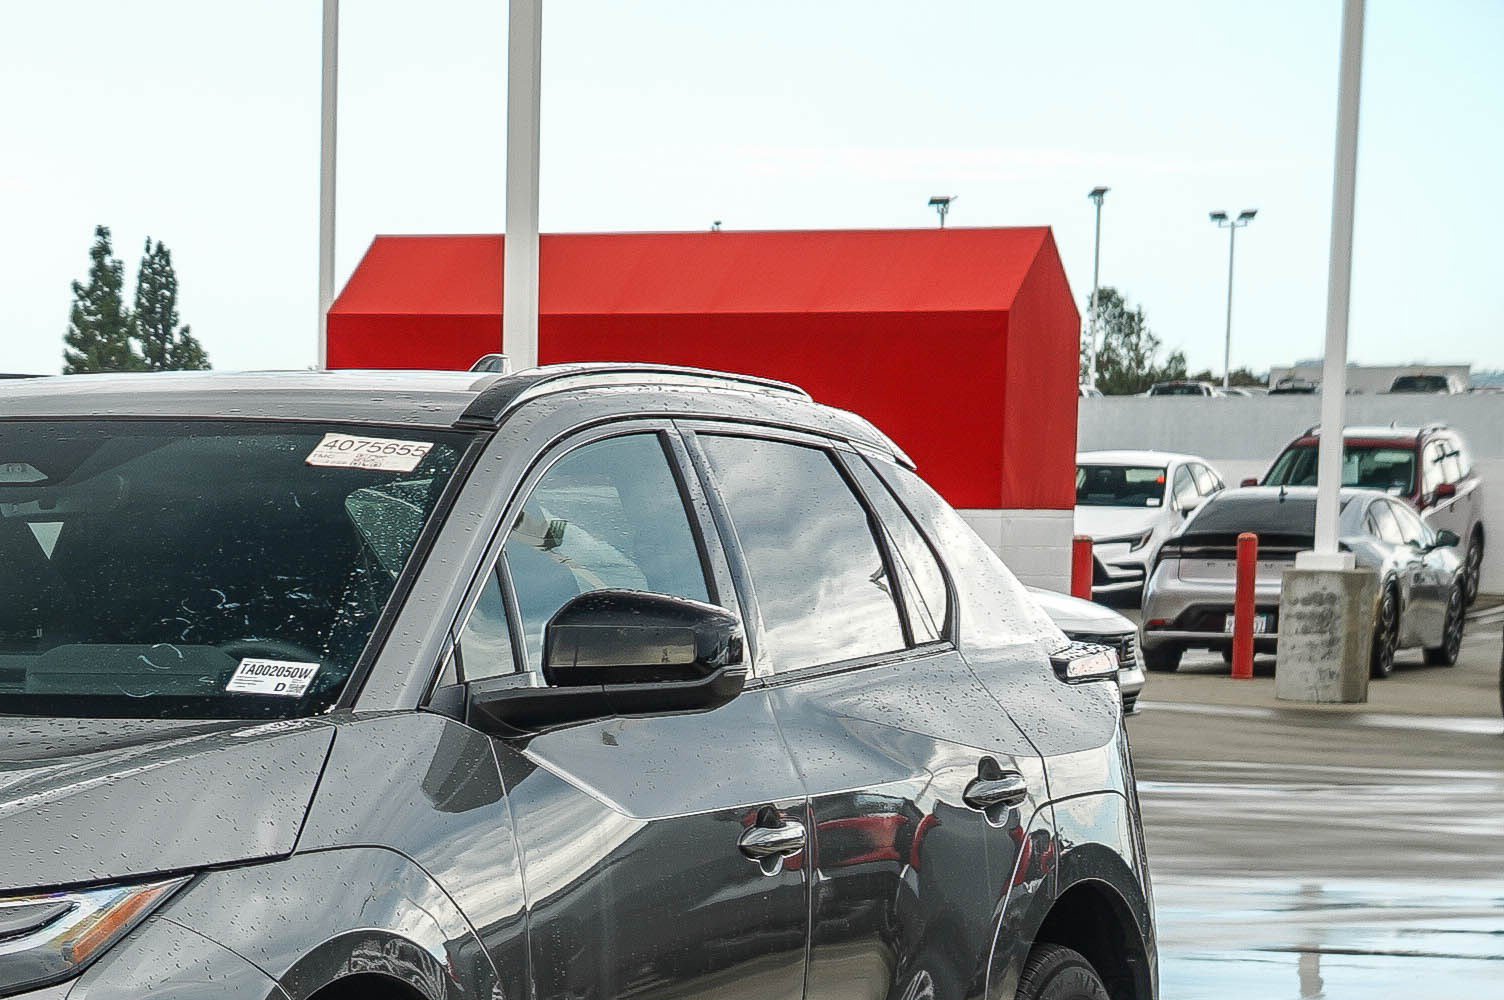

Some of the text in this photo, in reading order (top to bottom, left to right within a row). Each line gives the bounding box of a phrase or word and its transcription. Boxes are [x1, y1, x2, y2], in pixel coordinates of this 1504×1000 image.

[323, 439, 430, 457] 4075655
[240, 663, 313, 679] TA002050W
[273, 682, 286, 692] D
